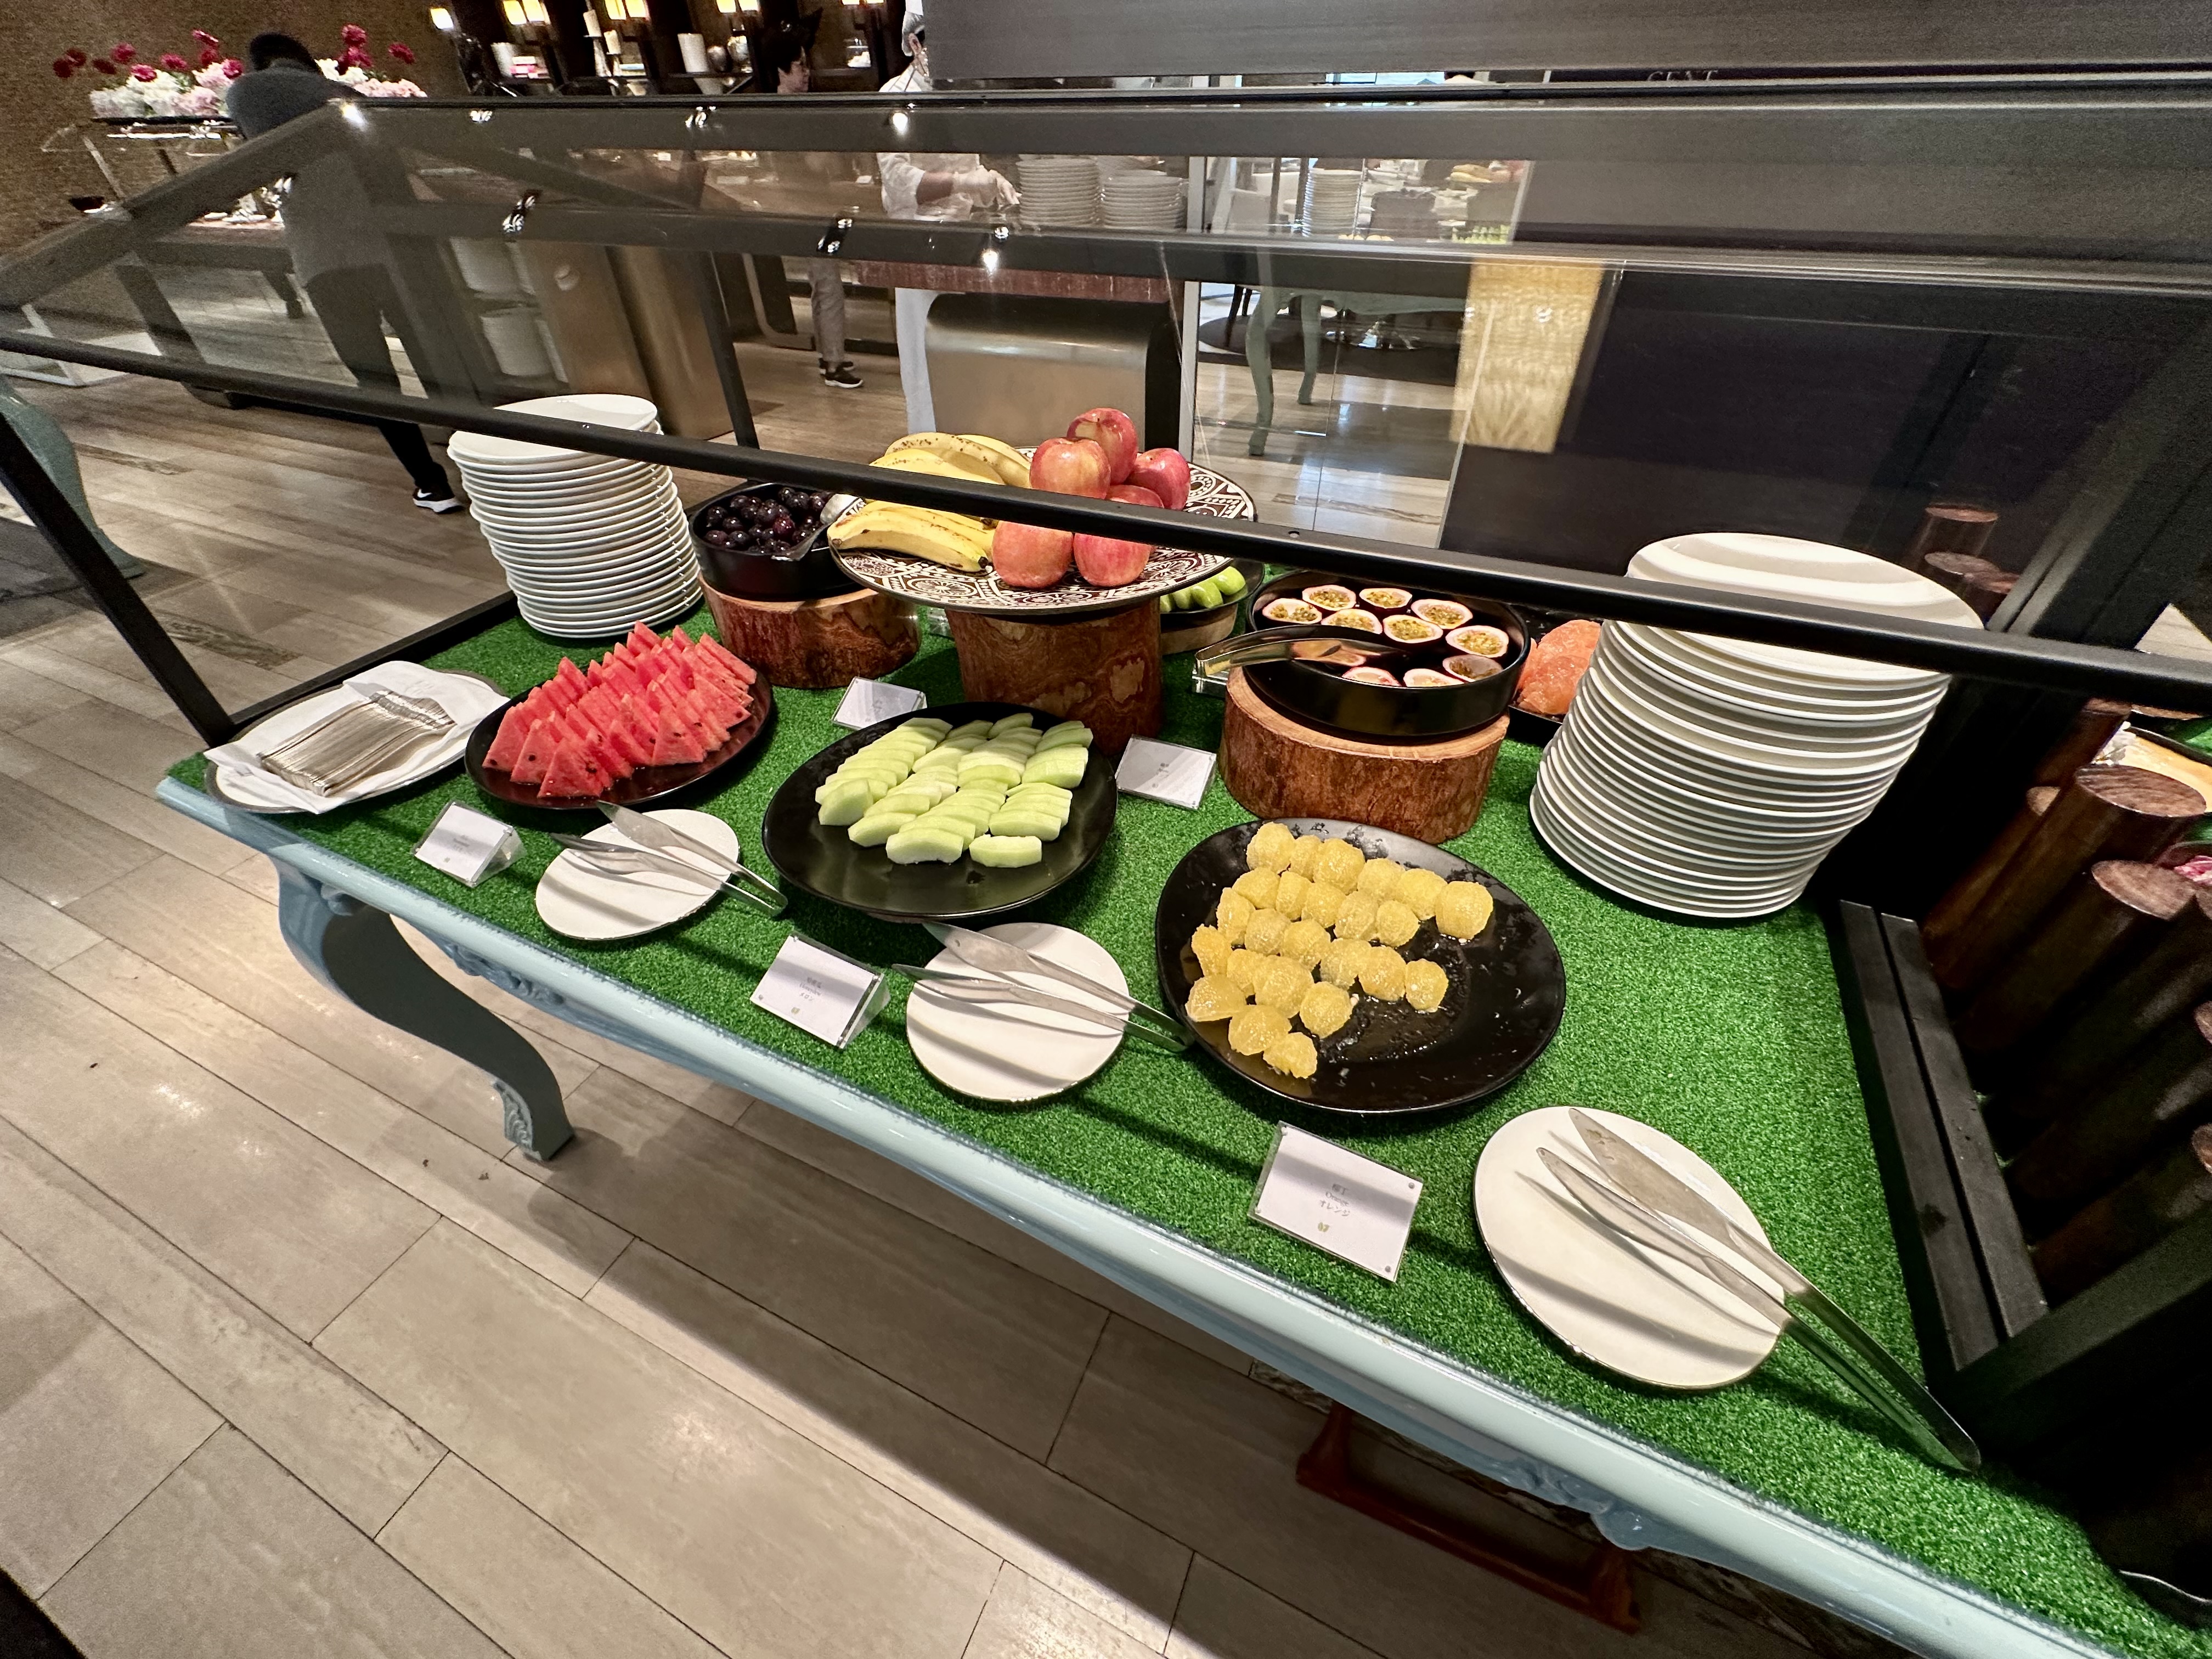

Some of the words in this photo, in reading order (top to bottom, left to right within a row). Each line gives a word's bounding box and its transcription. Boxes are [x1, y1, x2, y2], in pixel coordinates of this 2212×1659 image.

[1325, 1192, 1349, 1206] Orange
[1319, 1199, 1351, 1217] オレンジ
